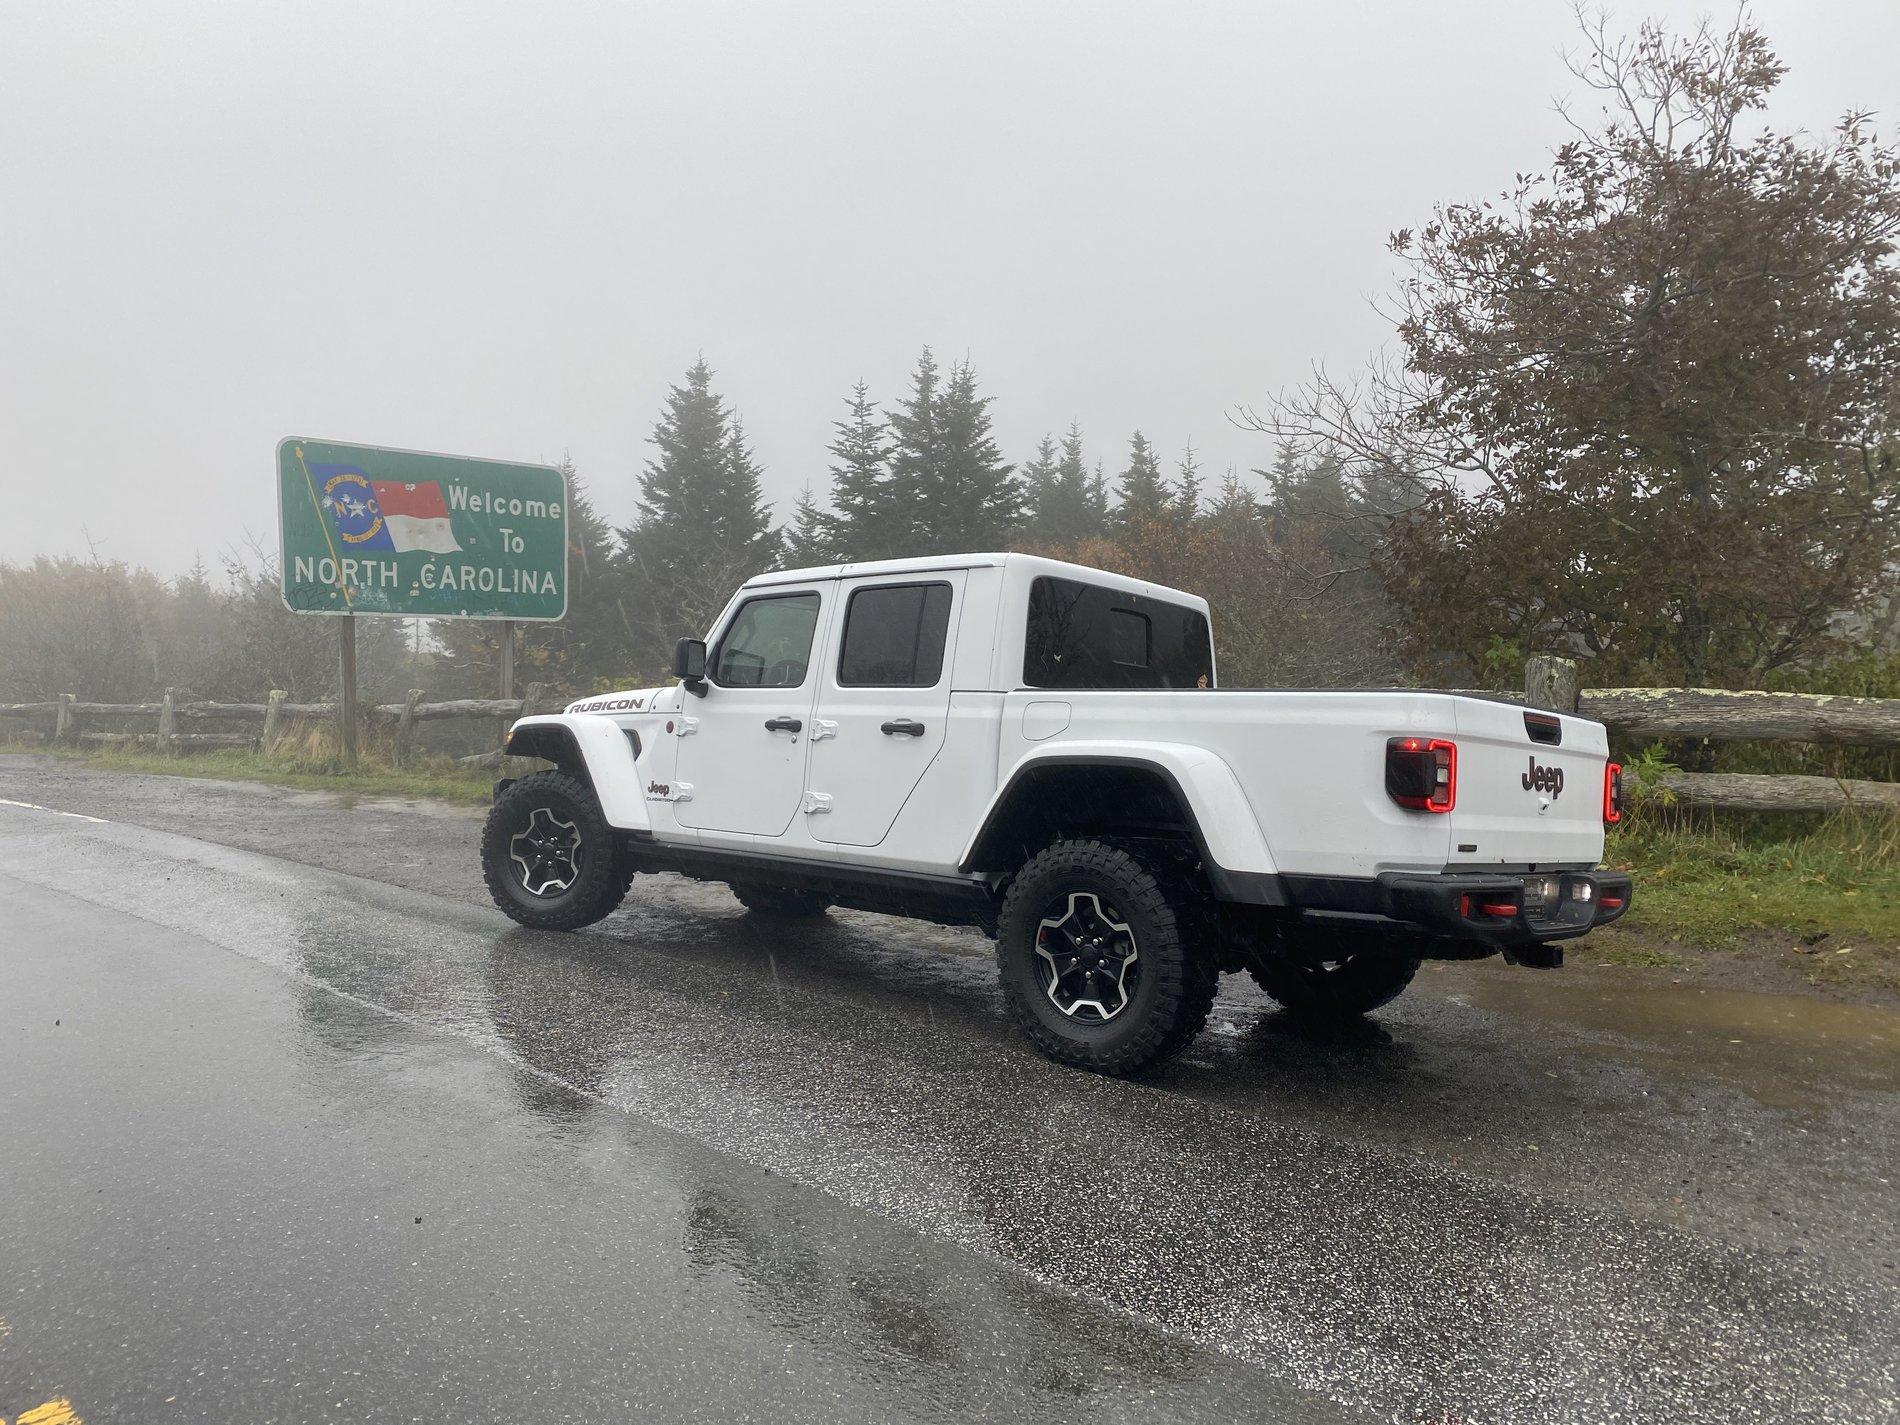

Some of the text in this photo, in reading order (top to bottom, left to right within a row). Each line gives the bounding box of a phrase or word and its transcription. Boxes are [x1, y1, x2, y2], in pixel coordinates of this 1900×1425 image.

[334, 499, 378, 518] N C
[448, 485, 561, 519] Welcome
[499, 528, 524, 553] To
[295, 556, 557, 595] NORTH CAROLINA
[570, 698, 644, 714] RUBICON
[648, 780, 670, 797] Jeep
[1522, 756, 1564, 800] Jeep
